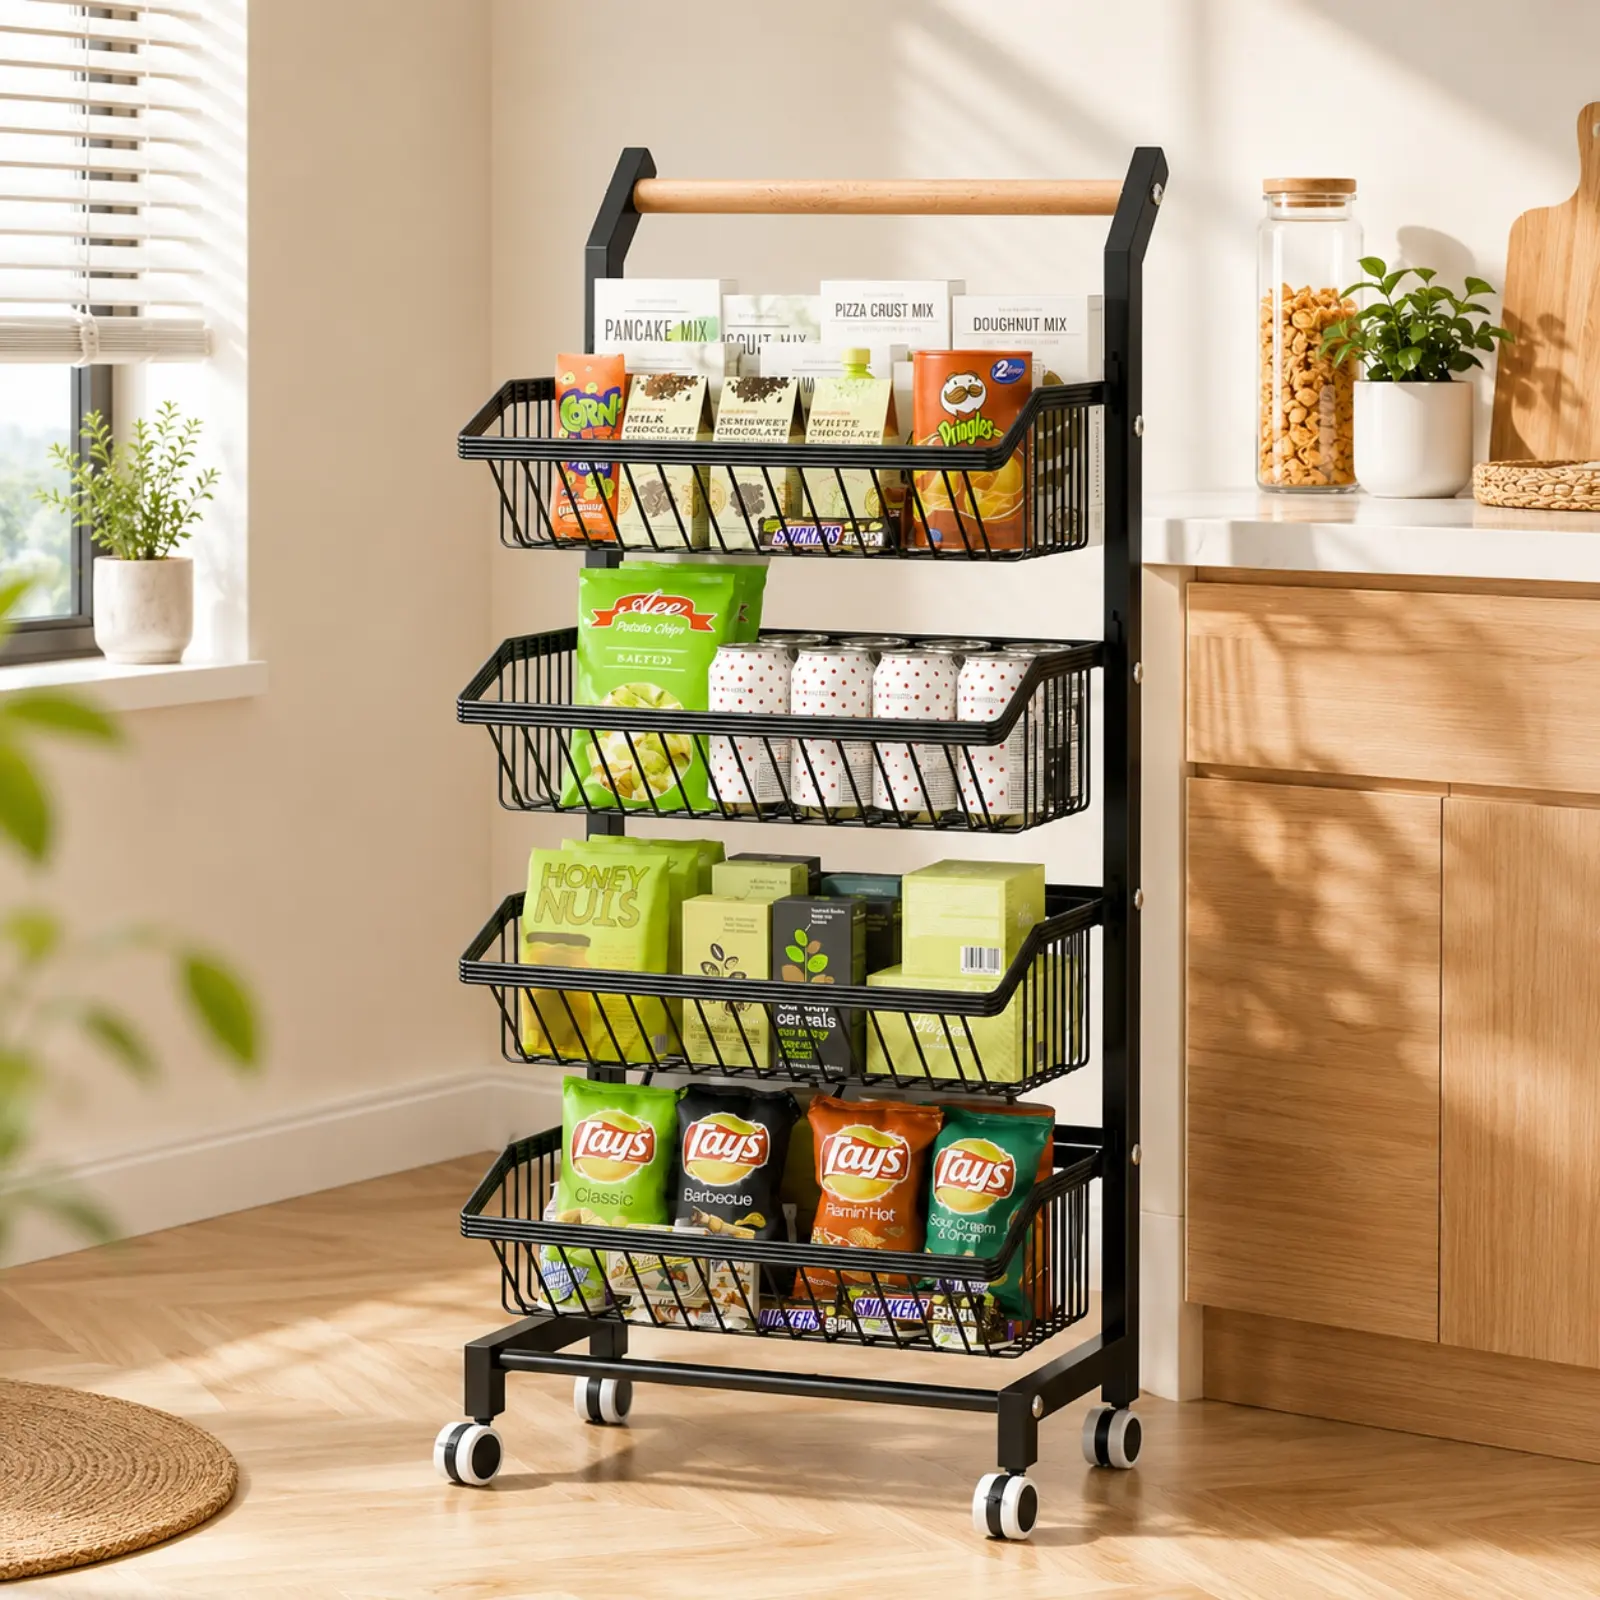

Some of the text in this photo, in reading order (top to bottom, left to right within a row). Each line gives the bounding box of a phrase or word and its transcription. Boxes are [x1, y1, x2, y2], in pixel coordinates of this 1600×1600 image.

[835, 303, 934, 318] PIZZA CRUST MIX
[605, 319, 707, 342] PANCAKE MIX
[973, 317, 1067, 331] DOUGHNUT MIX
[560, 393, 618, 432] CORN
[627, 415, 664, 423] MILK
[625, 425, 695, 435] CHOCOLATE
[812, 418, 860, 428] WHITE
[938, 411, 993, 447] Pringles
[716, 427, 787, 436] CHOCOLATE
[809, 429, 881, 438] CHOCOLATE
[541, 862, 650, 892] HONEY
[575, 1187, 634, 1207] Classic
[683, 1187, 753, 1206] Barbecue
[869, 1207, 896, 1222] Hot
